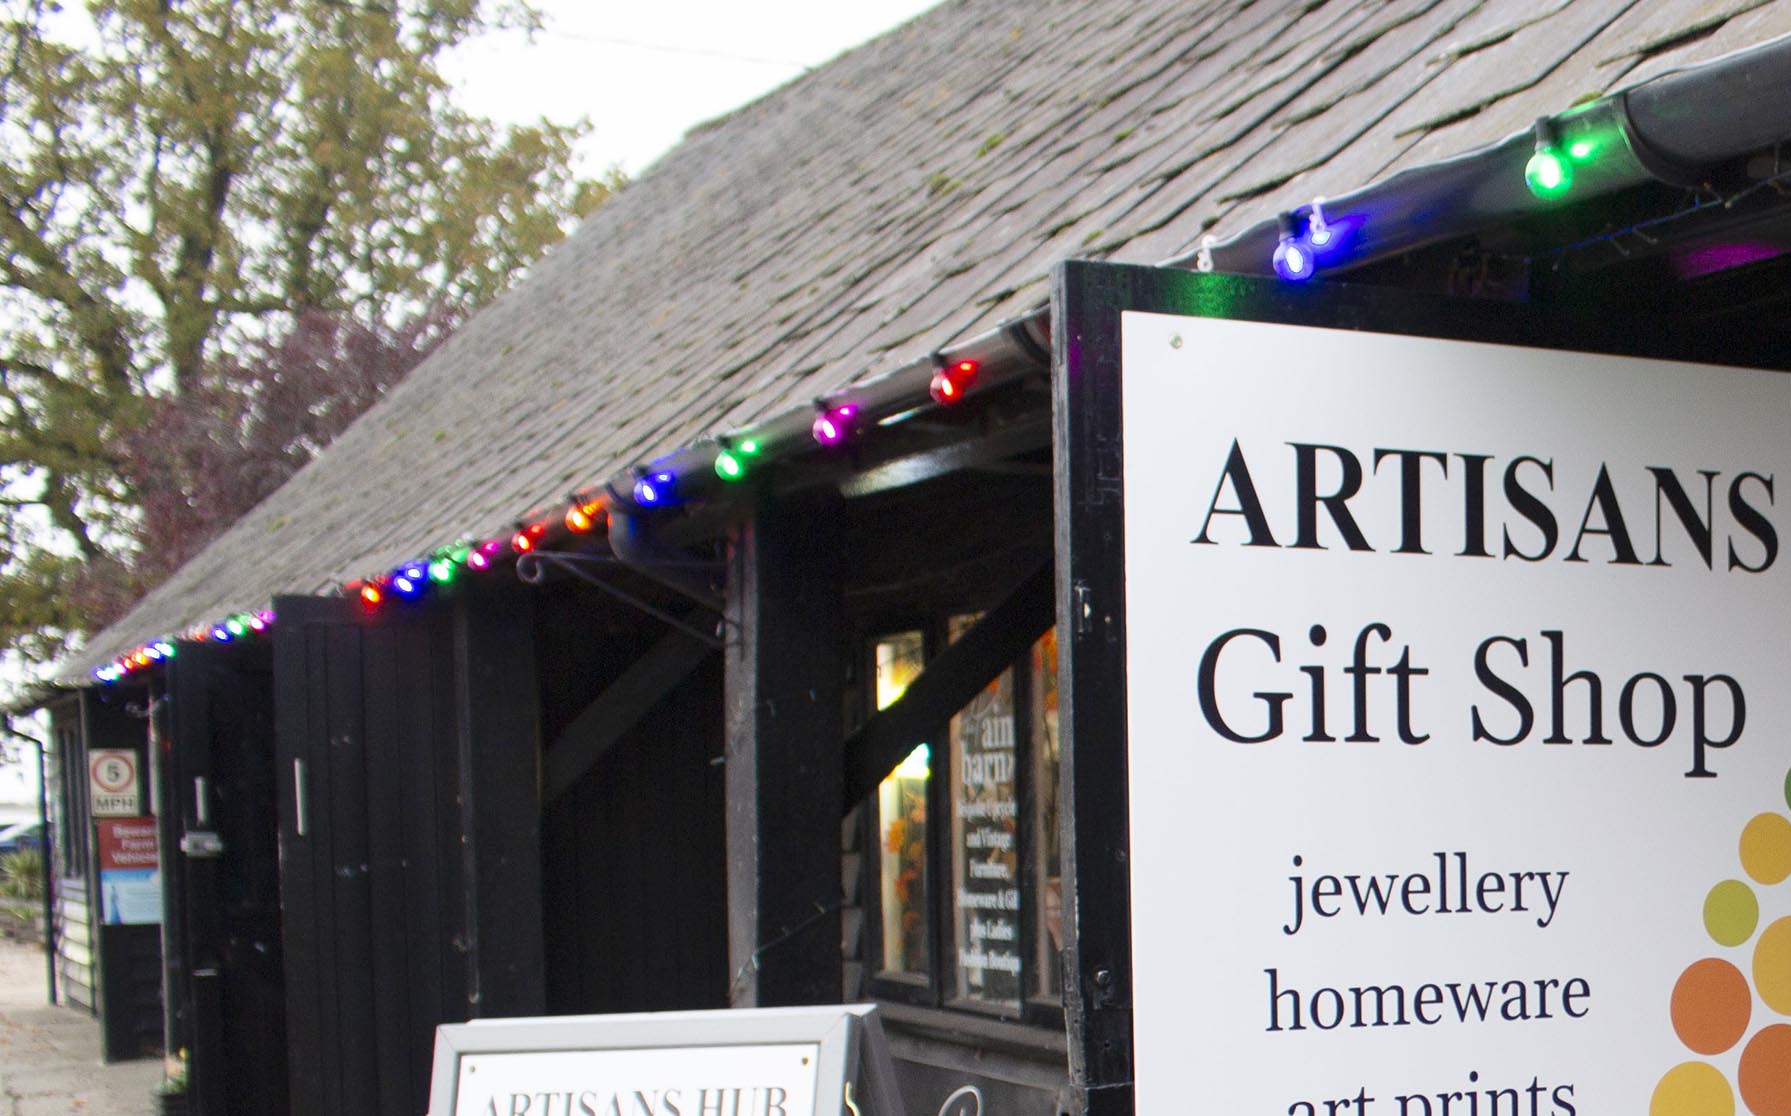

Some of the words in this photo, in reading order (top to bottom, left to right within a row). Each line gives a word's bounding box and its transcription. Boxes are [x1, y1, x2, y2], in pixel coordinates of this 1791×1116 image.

[1190, 436, 1780, 574] ARTISANS
[1197, 623, 1430, 746] Gift
[1470, 631, 1746, 778] Shop
[96, 797, 133, 810] MPH
[106, 762, 119, 783] 5
[1283, 852, 1570, 935] jewellery
[1264, 968, 1591, 1032] homeware
